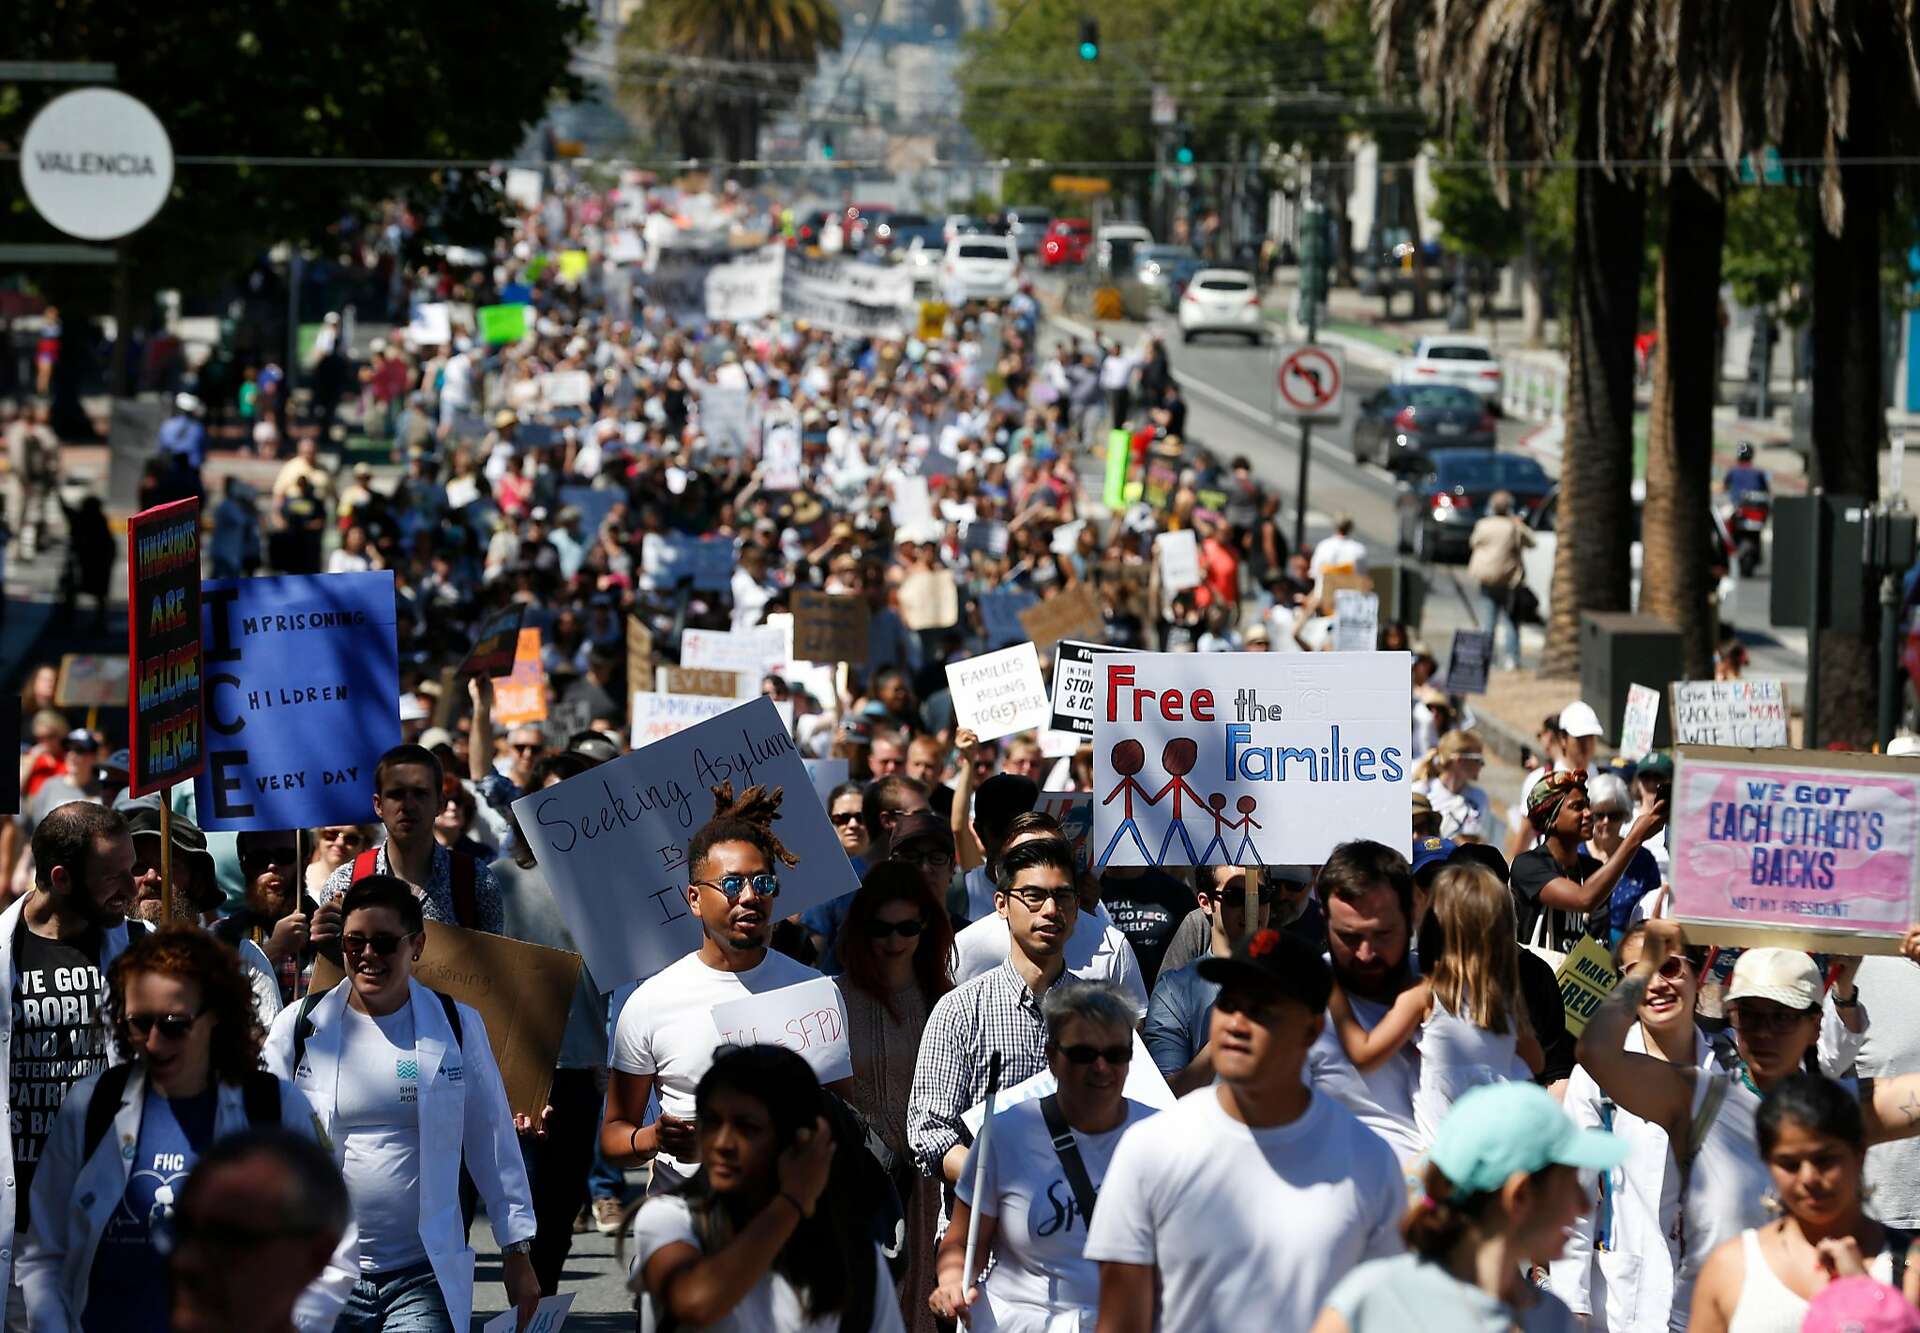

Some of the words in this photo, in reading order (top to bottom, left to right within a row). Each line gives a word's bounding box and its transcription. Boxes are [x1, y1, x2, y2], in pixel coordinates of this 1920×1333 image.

[34, 150, 156, 176] VALENCIA
[138, 519, 197, 581] IMMIGRANTS
[150, 586, 188, 637] ARE
[137, 640, 200, 713] WELCOME
[960, 656, 1024, 687] FAMILIES
[1067, 666, 1075, 674] IN
[1078, 668, 1092, 678] THE
[976, 677, 1026, 703] BELONG
[1067, 695, 1076, 709] &
[1106, 664, 1216, 722] Free
[1234, 688, 1283, 722] the
[972, 694, 1044, 725] TOGETHER
[148, 704, 199, 774] HERE!
[1683, 726, 1722, 745] WTF
[1225, 723, 1403, 782] Families
[323, 767, 359, 786] DAY
[536, 773, 692, 852] Seeking
[692, 729, 795, 787] Asylum
[1747, 782, 1786, 802] WE
[1795, 785, 1850, 806] GOT
[1709, 802, 1773, 844] EACH
[1782, 806, 1884, 851] OTHER'S
[1751, 847, 1836, 890] BACKS
[1118, 911, 1134, 920] GO
[1731, 897, 1755, 911] NOT
[1759, 899, 1777, 913] MY
[1783, 900, 1850, 918] PRESIDENT
[1575, 956, 1616, 988] MAKE
[11, 1031, 58, 1059] AND
[153, 1153, 185, 1171] FHC
